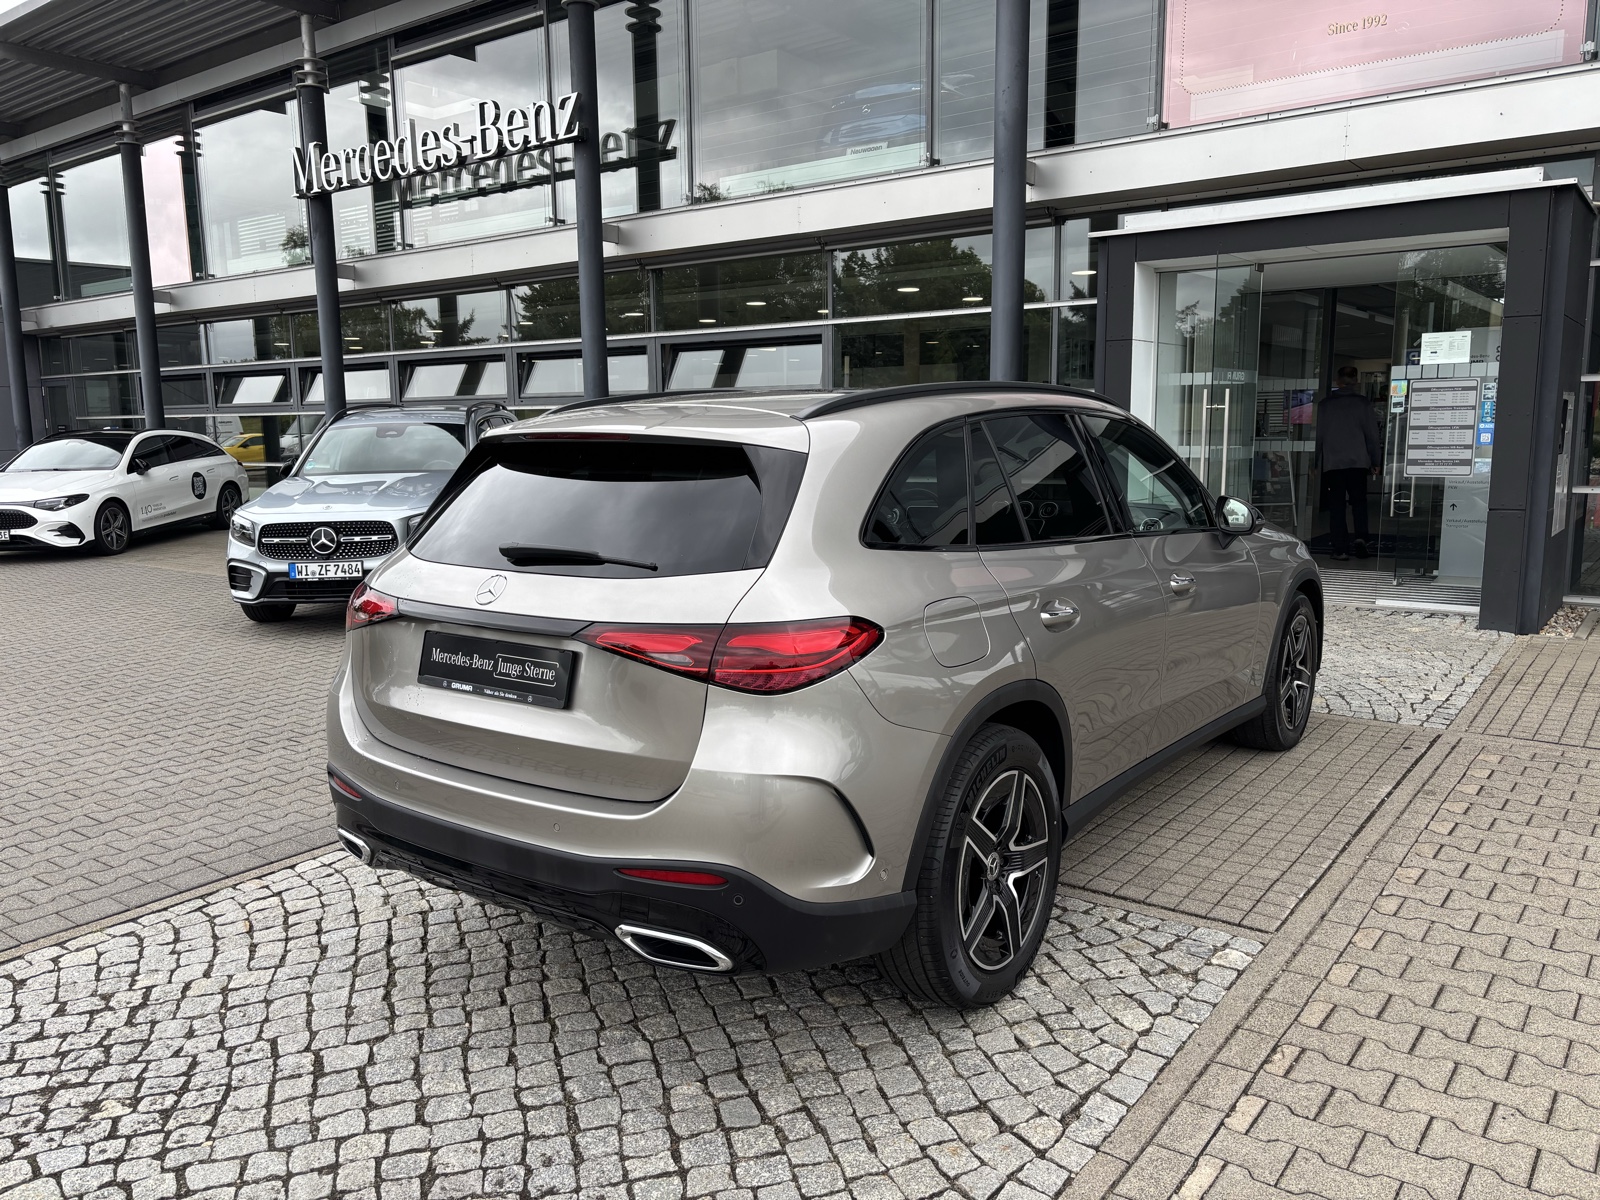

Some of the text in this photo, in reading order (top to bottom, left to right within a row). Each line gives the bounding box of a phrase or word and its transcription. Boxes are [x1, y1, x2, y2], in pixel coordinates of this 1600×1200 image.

[1327, 14, 1388, 36] Since 1992
[290, 91, 582, 198] Mercedes-Benz
[296, 565, 310, 577] WI
[430, 647, 556, 681] Mercedes-Benz Junge Sterne
[451, 682, 473, 692] GRUMA
